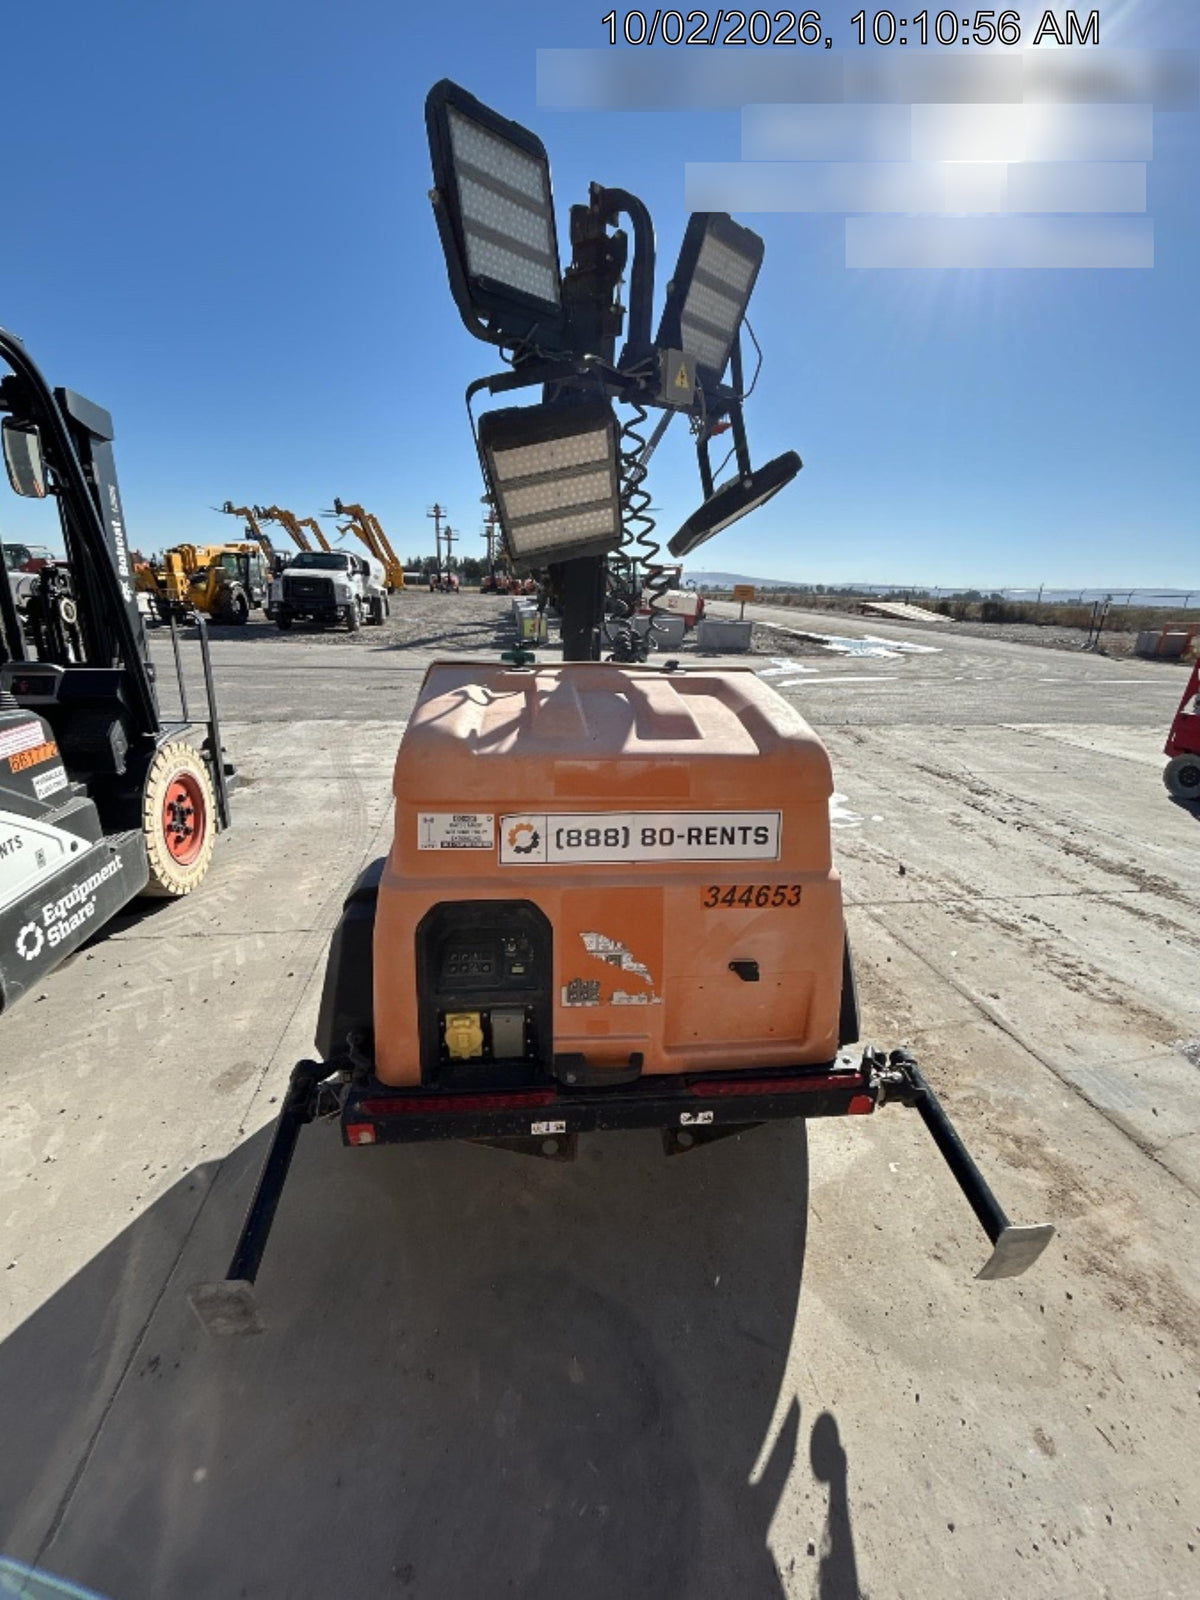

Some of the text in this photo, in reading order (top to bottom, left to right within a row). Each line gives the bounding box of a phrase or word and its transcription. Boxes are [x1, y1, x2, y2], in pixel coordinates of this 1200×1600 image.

[111, 520, 130, 577] Bobcat
[555, 825, 769, 850] (888) 80-RENTS
[42, 854, 123, 927] Equipment
[703, 884, 802, 908] 344653
